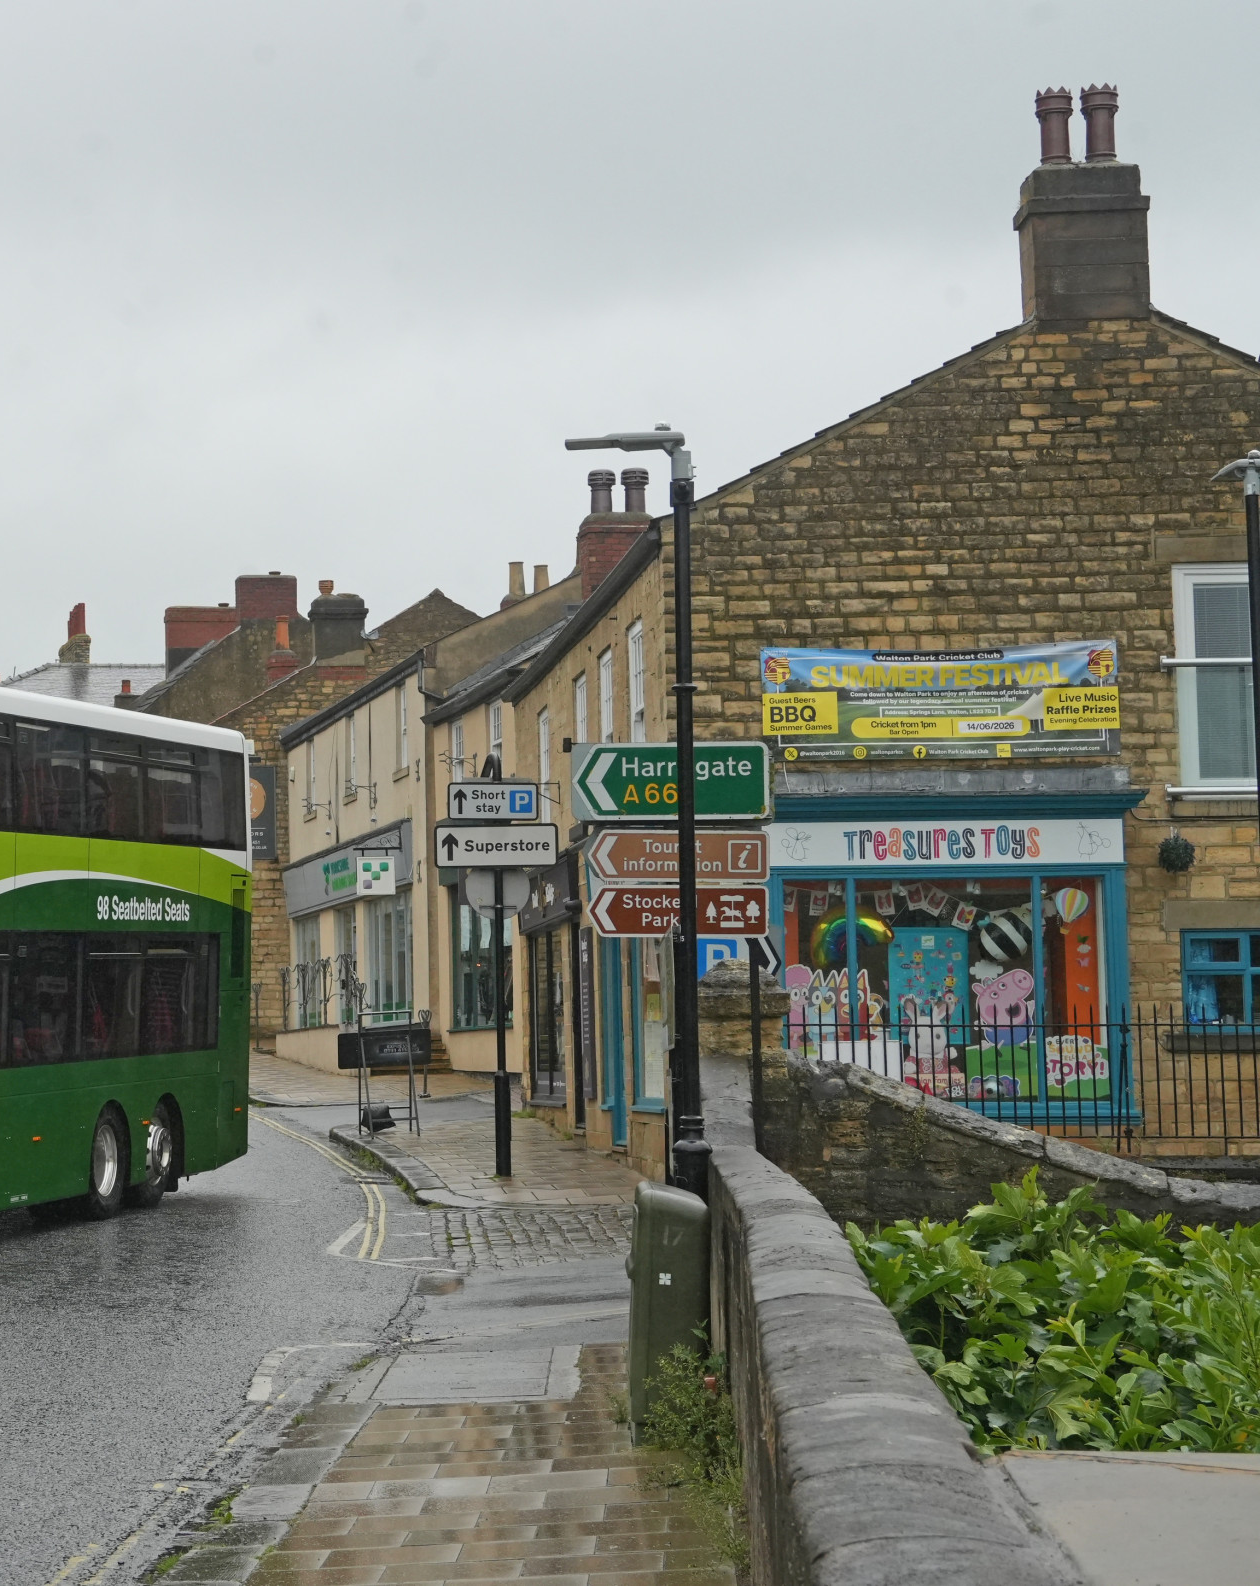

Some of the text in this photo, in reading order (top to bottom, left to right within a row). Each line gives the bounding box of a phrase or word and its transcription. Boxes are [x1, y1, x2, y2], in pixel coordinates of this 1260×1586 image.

[938, 653, 975, 661] Cricket
[810, 661, 1069, 688] SUMMER FESTIVAL
[793, 696, 816, 704] Beers
[1058, 692, 1116, 703] Live Music
[770, 705, 817, 723] BBQ
[1046, 705, 1117, 715] Raffle Prizes
[870, 720, 937, 730] Cricket from 1pm
[966, 721, 1015, 731] 14/06/2026
[621, 756, 752, 781] Harrgate
[471, 789, 530, 811] Short P
[475, 803, 501, 814] stay
[464, 839, 550, 854] Superstore
[642, 839, 702, 854] Tourt
[622, 856, 722, 872] informion
[97, 895, 190, 922] 98 Seatbelted Seats
[622, 894, 698, 909] Stocke
[641, 913, 680, 927] Park
